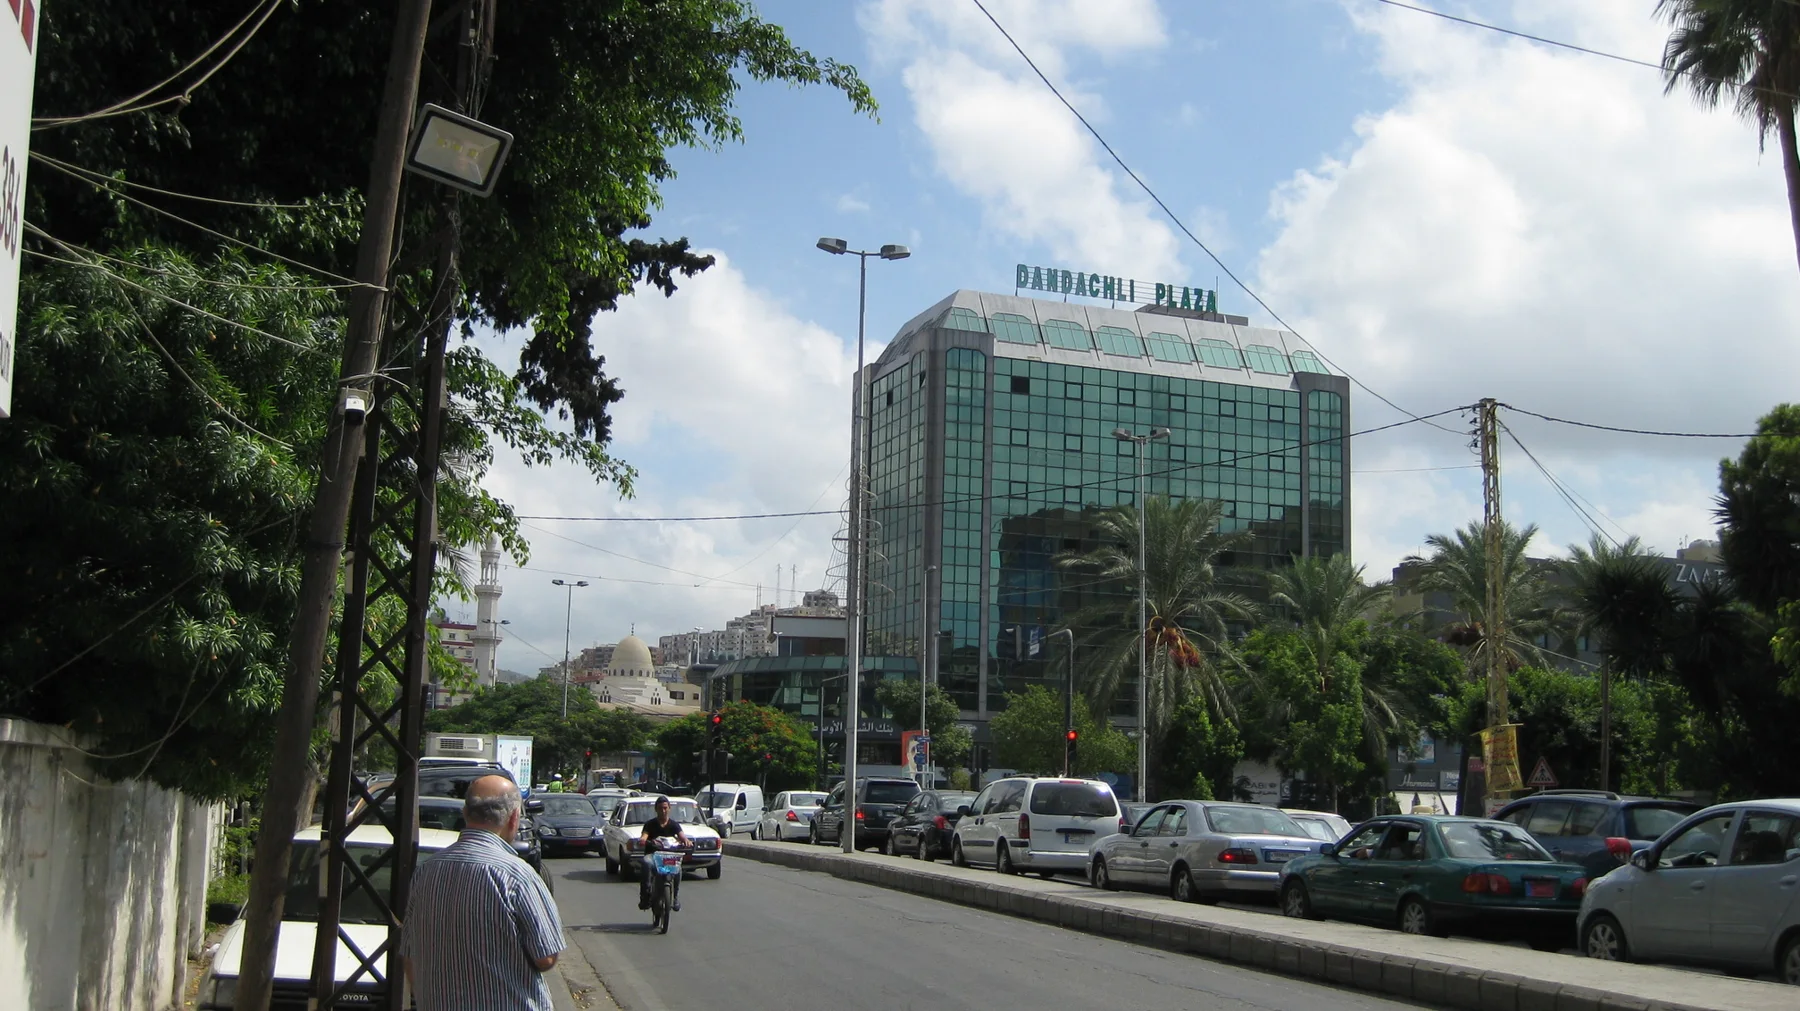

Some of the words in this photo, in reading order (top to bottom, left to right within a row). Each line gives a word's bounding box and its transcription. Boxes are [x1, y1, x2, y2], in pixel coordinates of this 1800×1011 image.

[1016, 263, 1135, 302] DANDACHLI
[1155, 282, 1217, 313] PLAZA
[1676, 563, 1736, 586] ZAAT
[844, 722, 874, 736] الش
[875, 722, 894, 736] بنك
